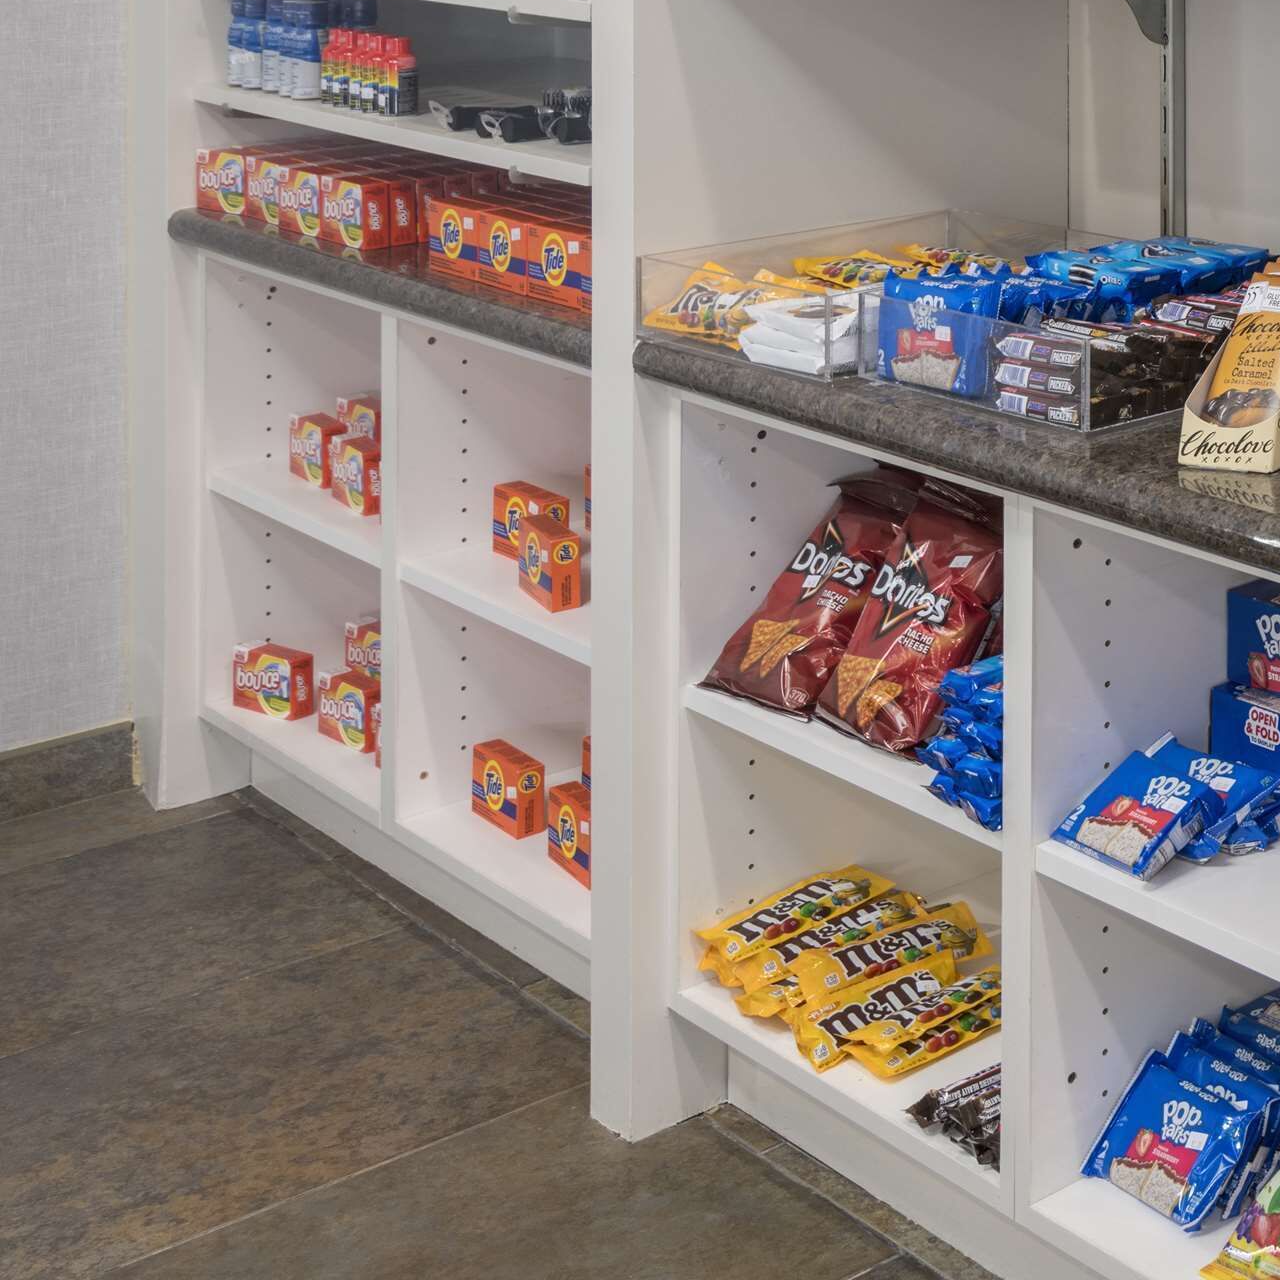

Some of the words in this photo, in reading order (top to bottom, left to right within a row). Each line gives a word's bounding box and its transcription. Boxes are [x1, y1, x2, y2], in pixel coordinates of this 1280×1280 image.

[441, 223, 460, 249] Tide
[489, 236, 509, 258] Tide
[543, 245, 565, 273] Tide
[1236, 356, 1275, 369] Salted
[1231, 368, 1273, 380] Caramel
[1180, 429, 1274, 458] Chocolove
[792, 543, 872, 587] Doritos
[871, 564, 952, 624] Doritos
[906, 626, 935, 644] NACHO
[1249, 706, 1278, 726] OPEN
[1255, 725, 1280, 745] FOLD
